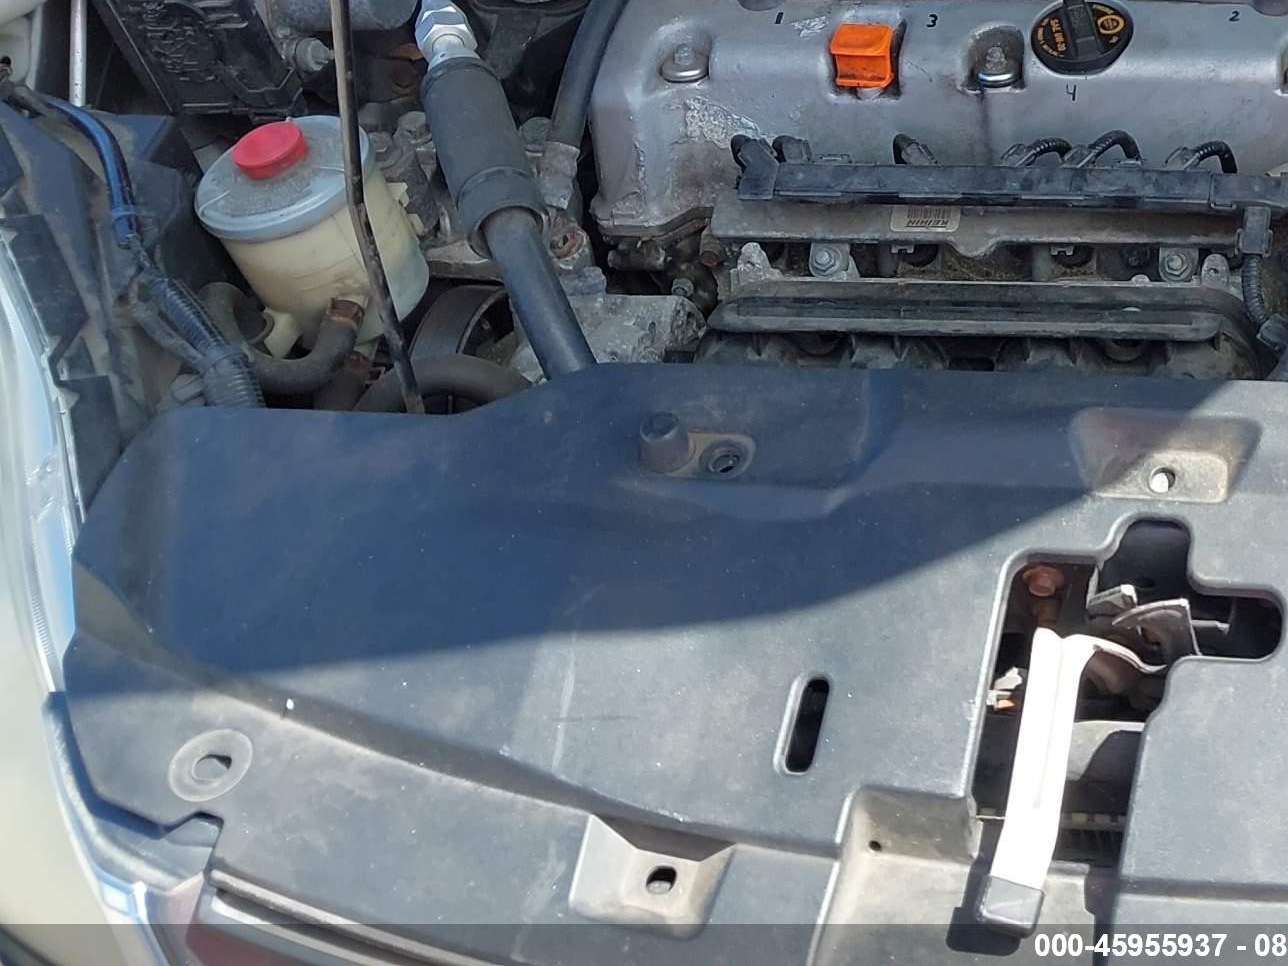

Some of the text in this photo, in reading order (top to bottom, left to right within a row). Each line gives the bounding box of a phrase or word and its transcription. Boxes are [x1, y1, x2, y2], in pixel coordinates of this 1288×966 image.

[926, 14, 939, 27] 3
[1229, 10, 1241, 22] 2
[1065, 83, 1077, 101] 4
